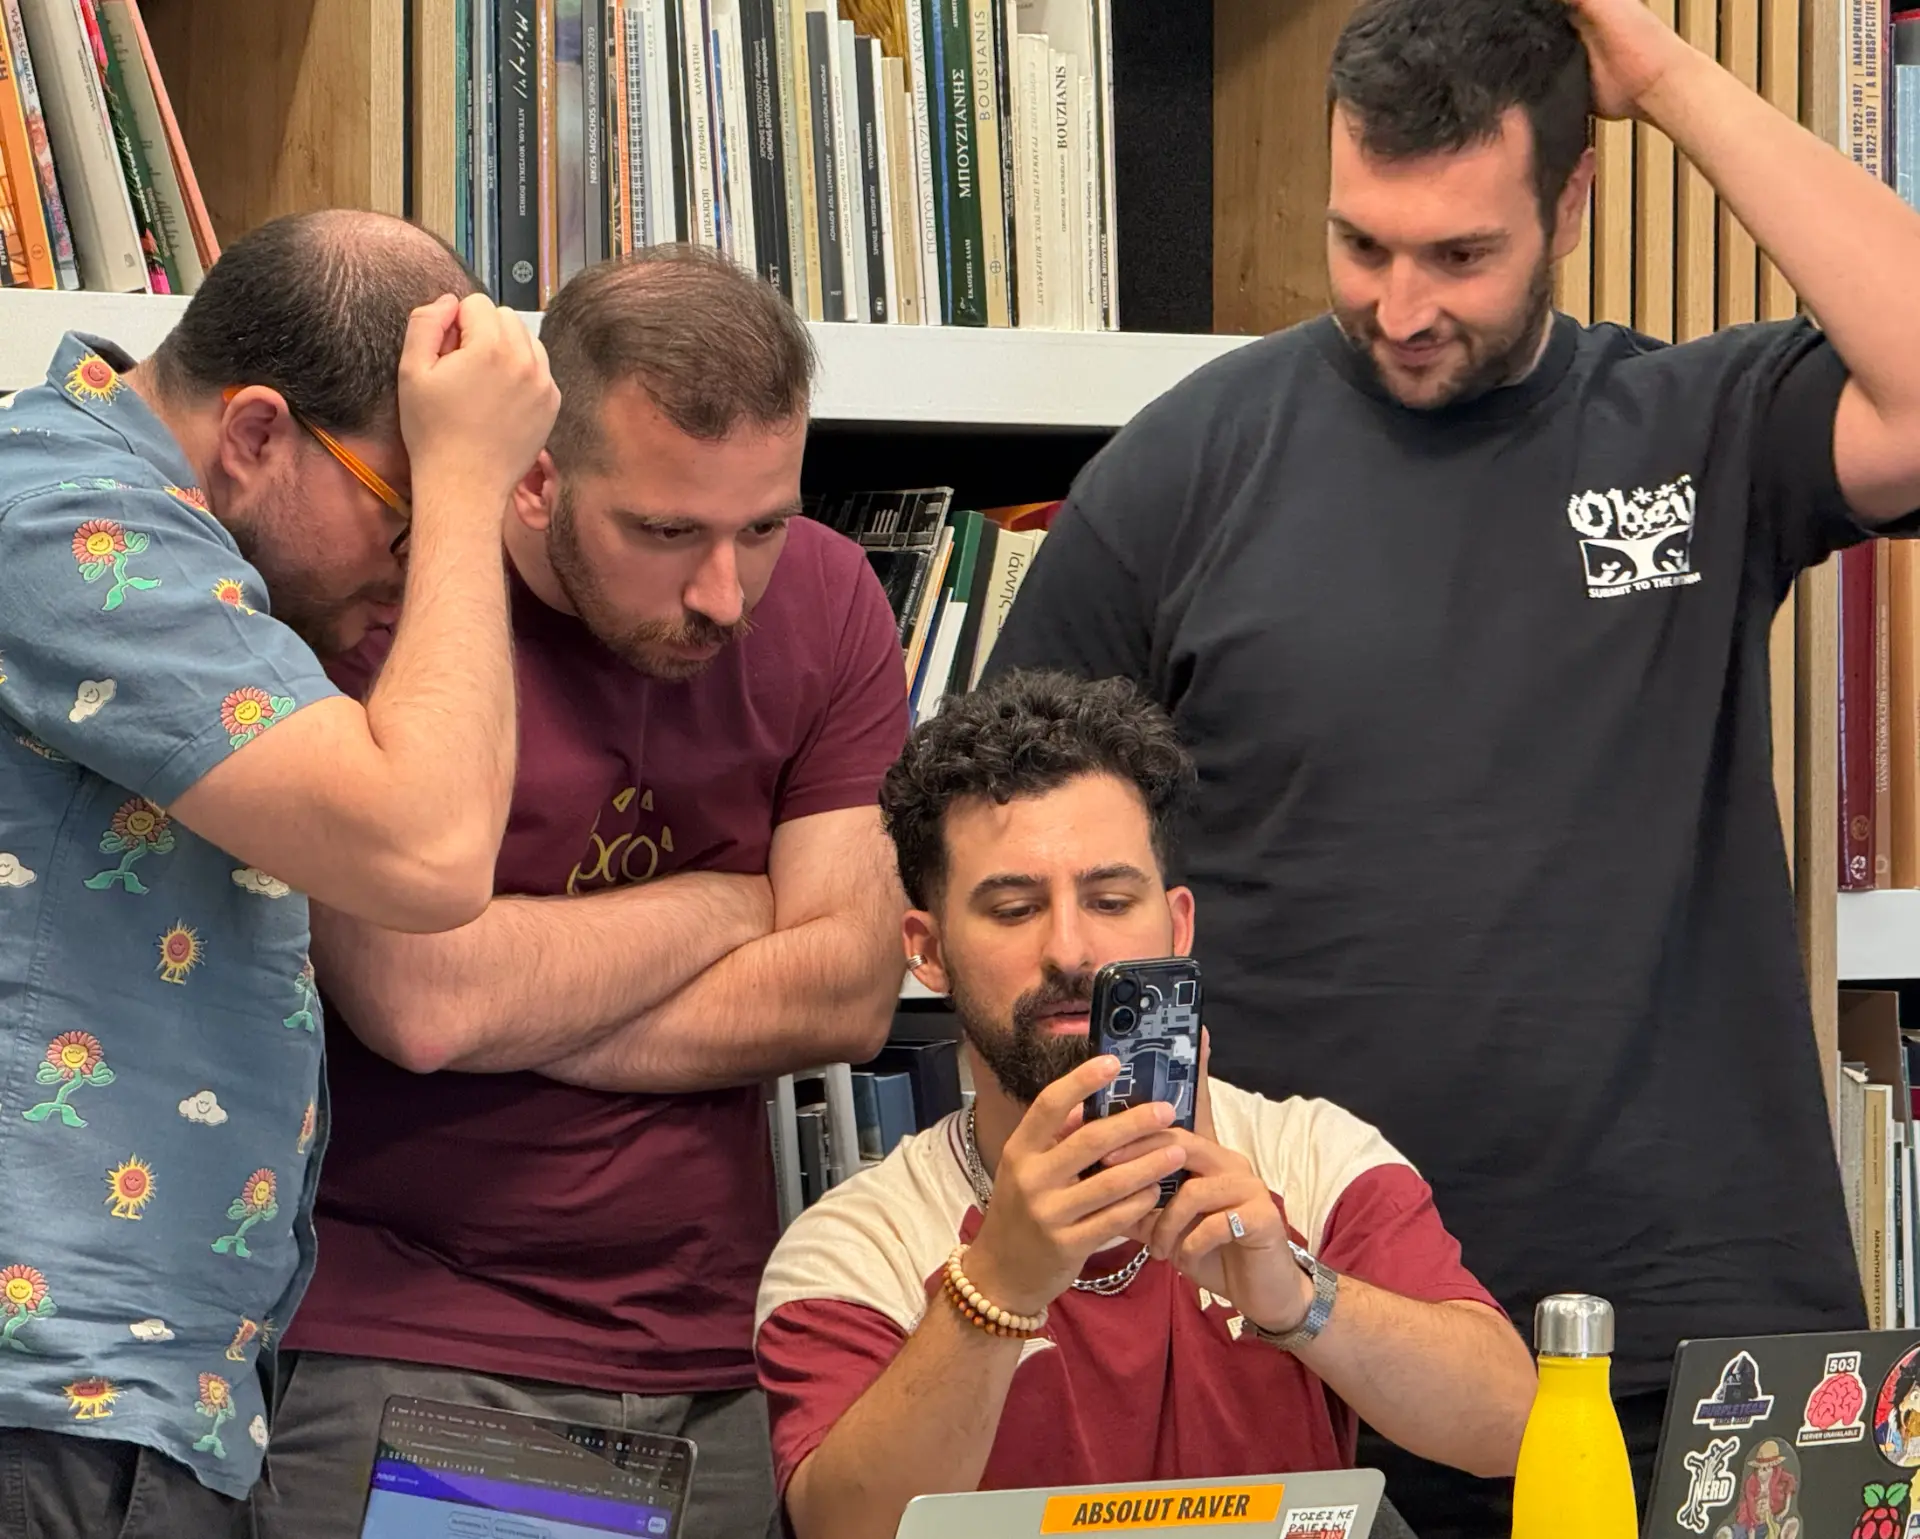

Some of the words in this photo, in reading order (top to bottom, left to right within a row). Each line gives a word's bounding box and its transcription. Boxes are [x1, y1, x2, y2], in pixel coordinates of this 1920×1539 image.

[586, 26, 596, 73] 2012-2019
[1864, 1, 1877, 77] RETROSPECTIVE
[974, 10, 991, 121] BOUSIANIS
[588, 107, 597, 154] MOSCHOS
[1055, 65, 1069, 149] BOUZIANIS
[952, 68, 973, 199] ΜΠΟΥΖΙΑΝΗΣ
[1633, 580, 1651, 592] TO
[1828, 1358, 1855, 1373] 503
[1072, 1497, 1175, 1526] ABSOLUT
[1177, 1494, 1251, 1520] RAVER
